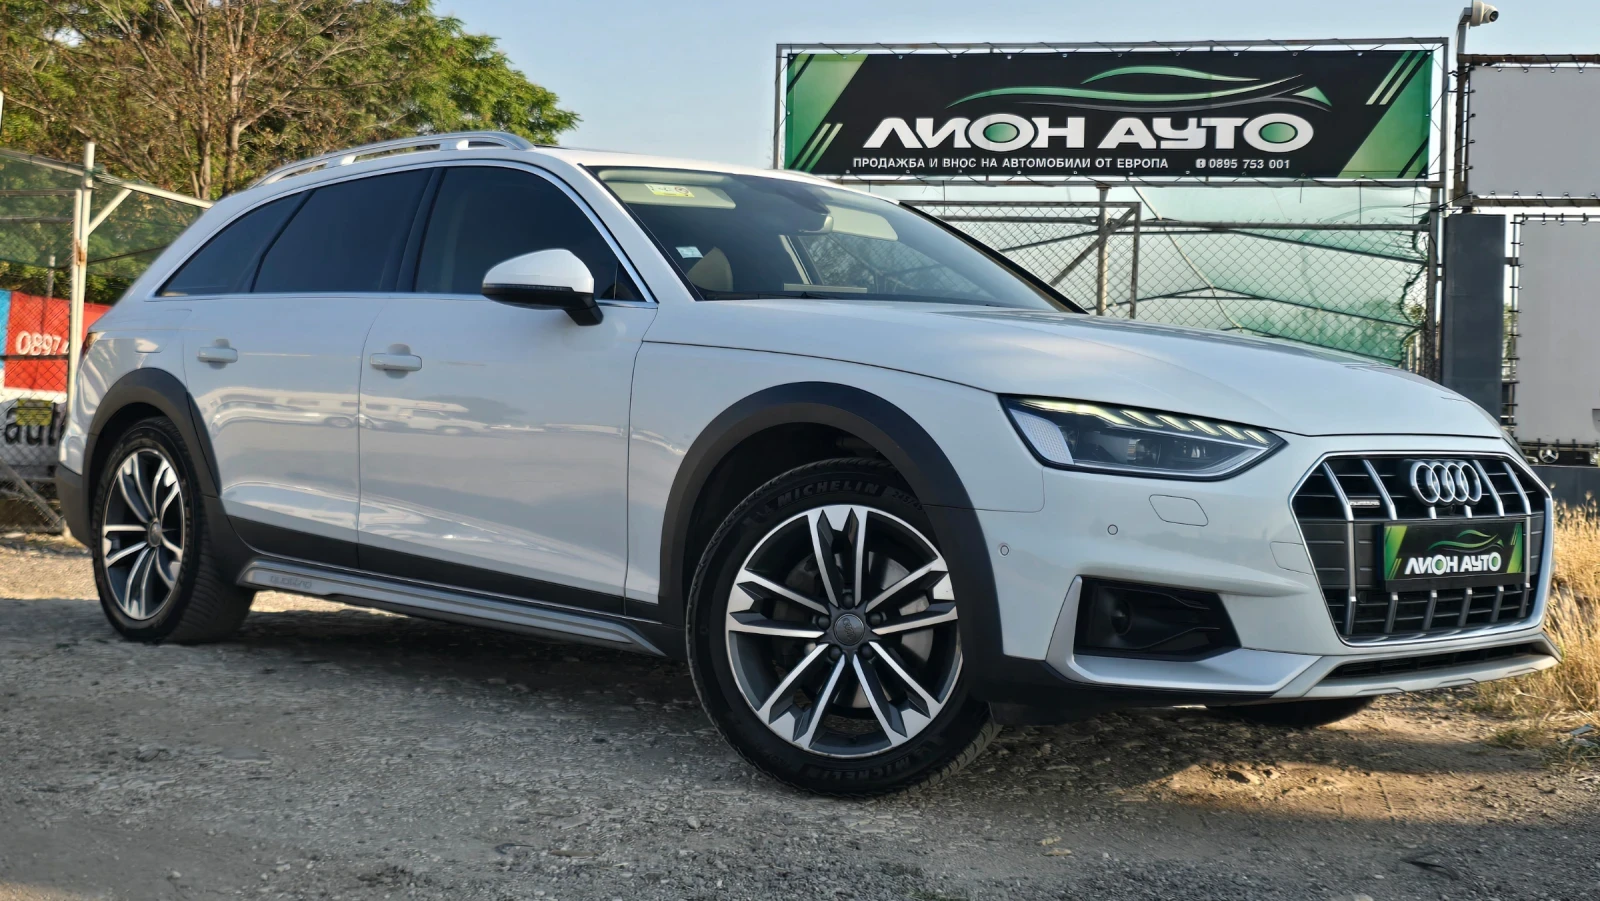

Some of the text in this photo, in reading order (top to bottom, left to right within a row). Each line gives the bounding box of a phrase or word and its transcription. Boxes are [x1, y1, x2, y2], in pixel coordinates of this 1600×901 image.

[863, 113, 1314, 153] ЛИОН АУТО
[853, 157, 1169, 169] ПРОДАЖБА И ВНОС НА АВТОМОБИЛИ ОТ ЕВРОПА
[1209, 158, 1290, 169] 0895 753 001
[15, 330, 62, 356] 0897
[4, 401, 65, 447] aut
[777, 480, 880, 507] MICHELIN
[1404, 552, 1502, 575] ЛИОН АУТО
